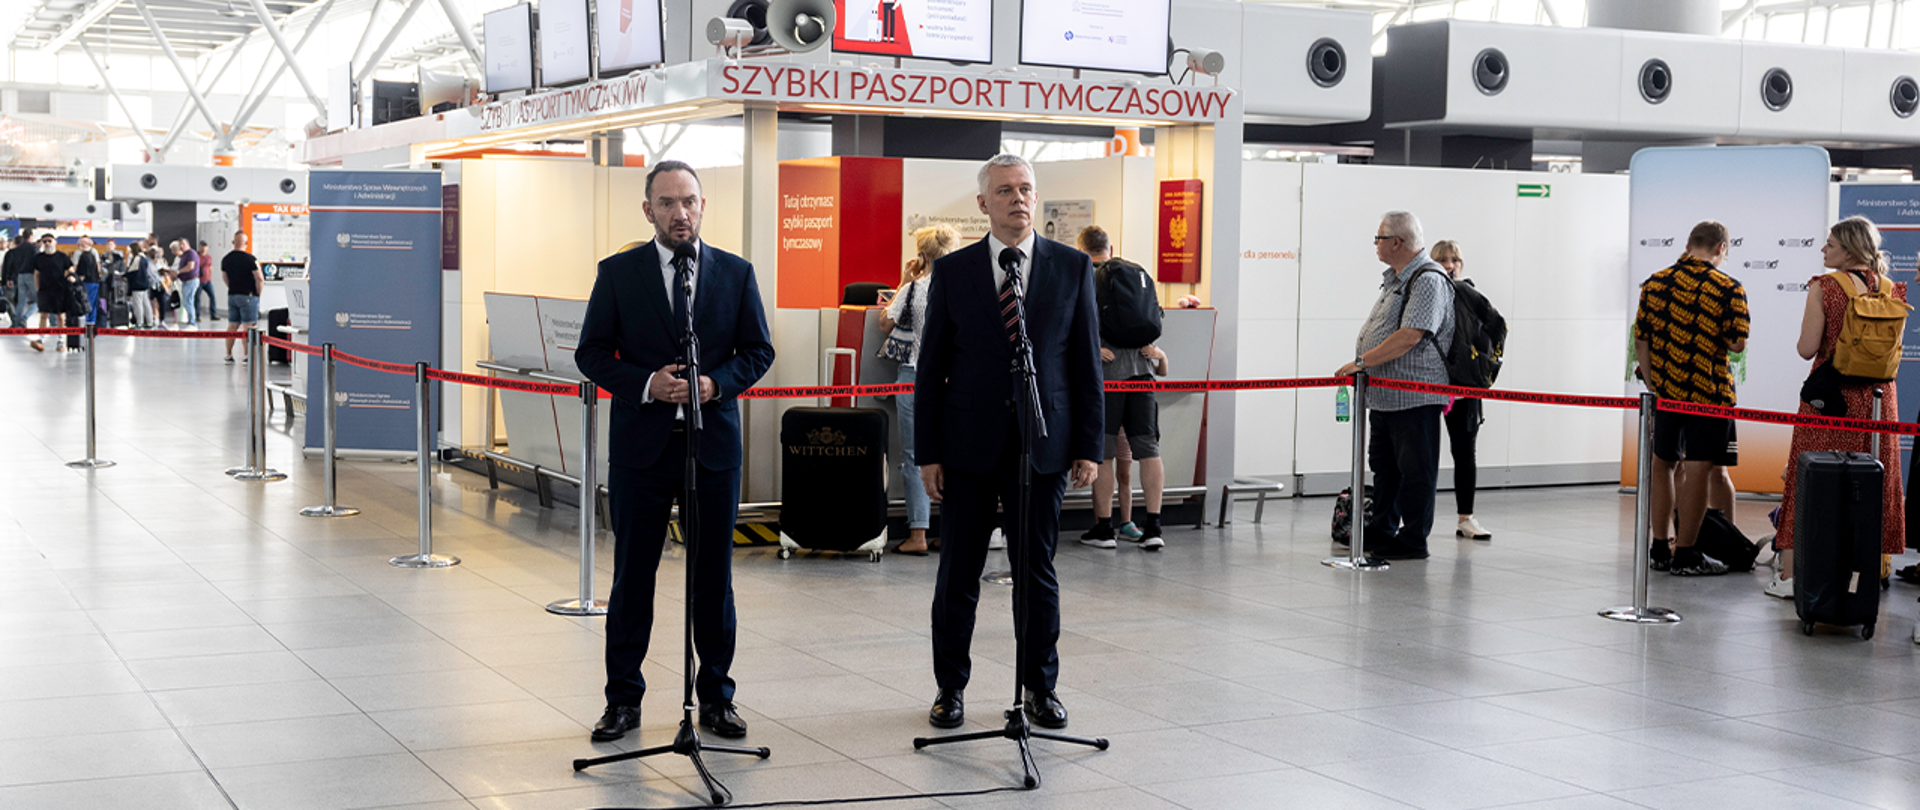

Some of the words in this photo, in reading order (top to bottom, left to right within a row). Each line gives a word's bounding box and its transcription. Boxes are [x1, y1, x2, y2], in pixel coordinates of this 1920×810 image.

[722, 65, 839, 99] SZYBKI
[851, 71, 1012, 108] PASZPORT
[1018, 82, 1231, 118] TYMCZASOWY
[480, 103, 511, 130] SZYBKI
[512, 93, 562, 125] PASZPORT
[564, 76, 648, 117] TYMCZASOWY
[1111, 134, 1128, 156] D
[783, 194, 799, 211] Tutaj
[800, 194, 834, 210] otrzymasz
[1857, 199, 1907, 207] Ministerstwo
[783, 214, 804, 231] szybki
[804, 214, 833, 231] paszport
[783, 236, 823, 252] tymczasowy
[1243, 249, 1256, 259] dla
[1258, 250, 1296, 260] personelu
[757, 388, 793, 397] CHOPINA
[796, 388, 804, 396] W
[806, 386, 854, 396] WARSZAWIE
[866, 385, 900, 394] WARSAW
[1120, 382, 1153, 390] CHOPINA
[1220, 381, 1251, 389] WARSAW
[1371, 378, 1386, 387] PORT
[1387, 380, 1416, 391] LOTNICZY
[1465, 388, 1494, 398] CHOPINA
[1661, 400, 1681, 410] PORT
[1683, 403, 1721, 414] LOTNICZY
[1724, 409, 1737, 417] IM.
[1739, 410, 1787, 420] FRYDERYKA
[1790, 415, 1829, 426] CHOPINA
[1832, 419, 1841, 427] W
[1843, 420, 1900, 432] WARSZAWIE
[789, 445, 868, 456] WITTCHEN
